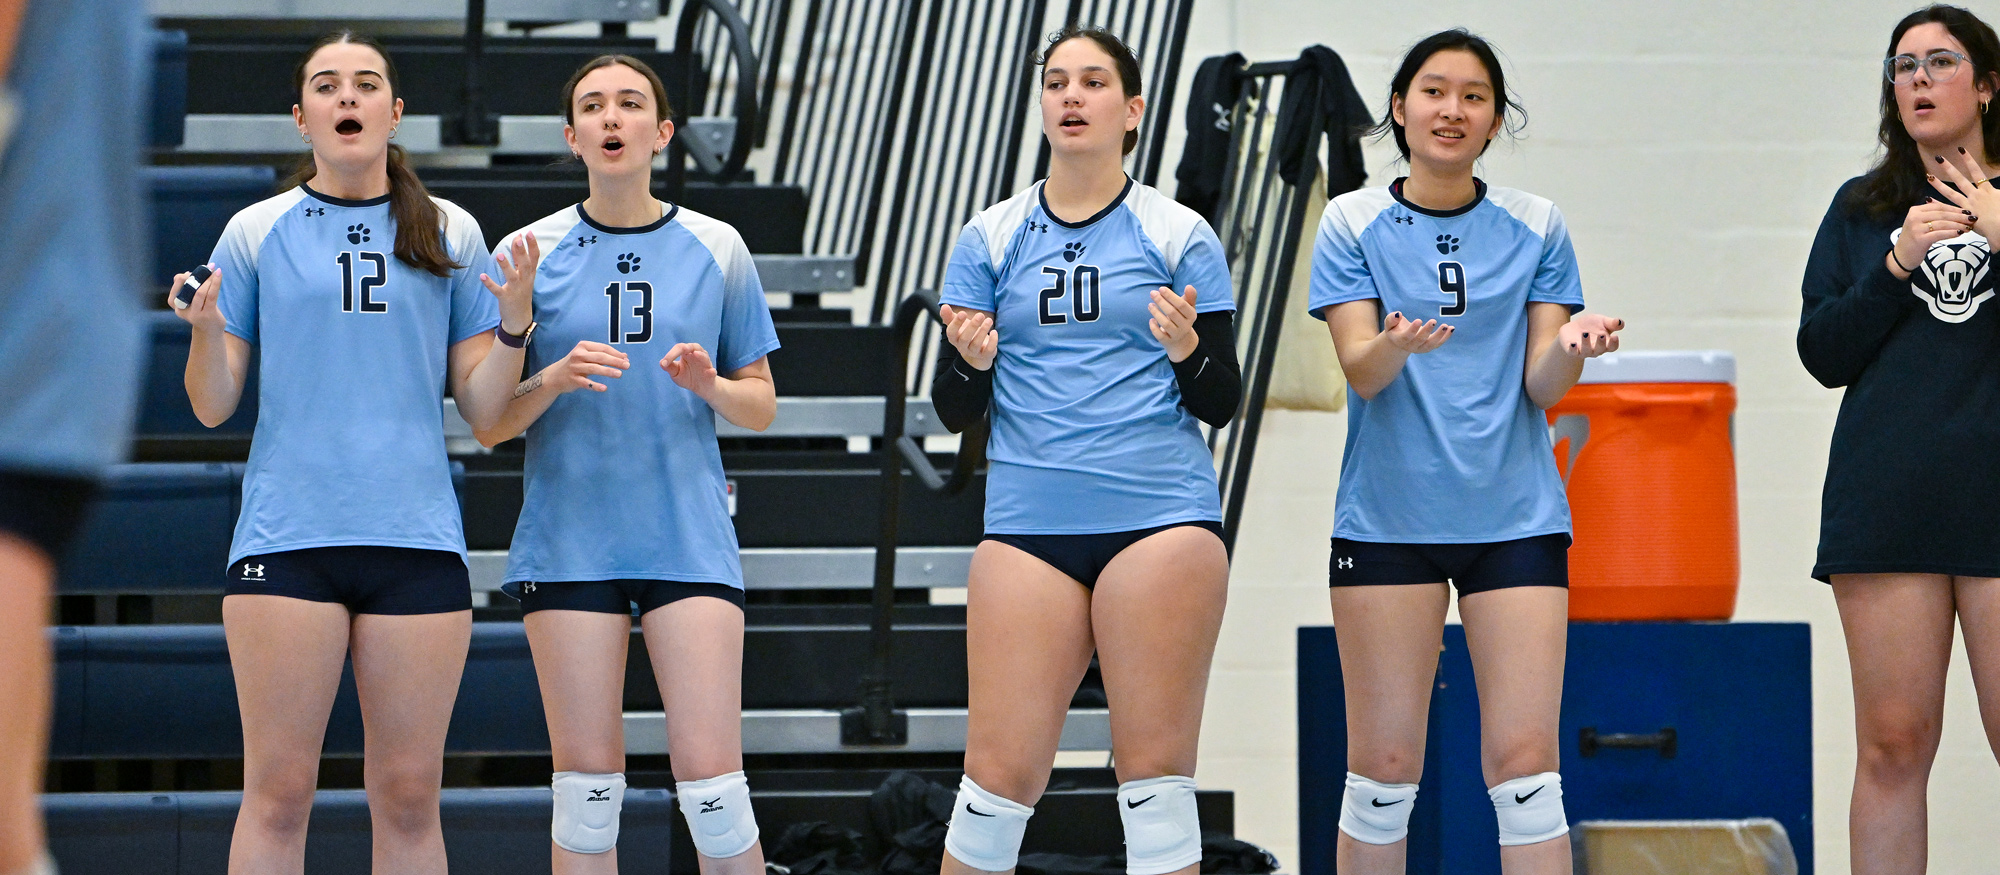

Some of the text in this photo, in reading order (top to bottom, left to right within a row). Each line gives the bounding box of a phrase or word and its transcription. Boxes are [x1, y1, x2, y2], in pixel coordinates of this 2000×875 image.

[336, 251, 388, 314] 12
[604, 281, 653, 344] 13
[1038, 264, 1101, 326] 20
[1437, 261, 1467, 317] 9
